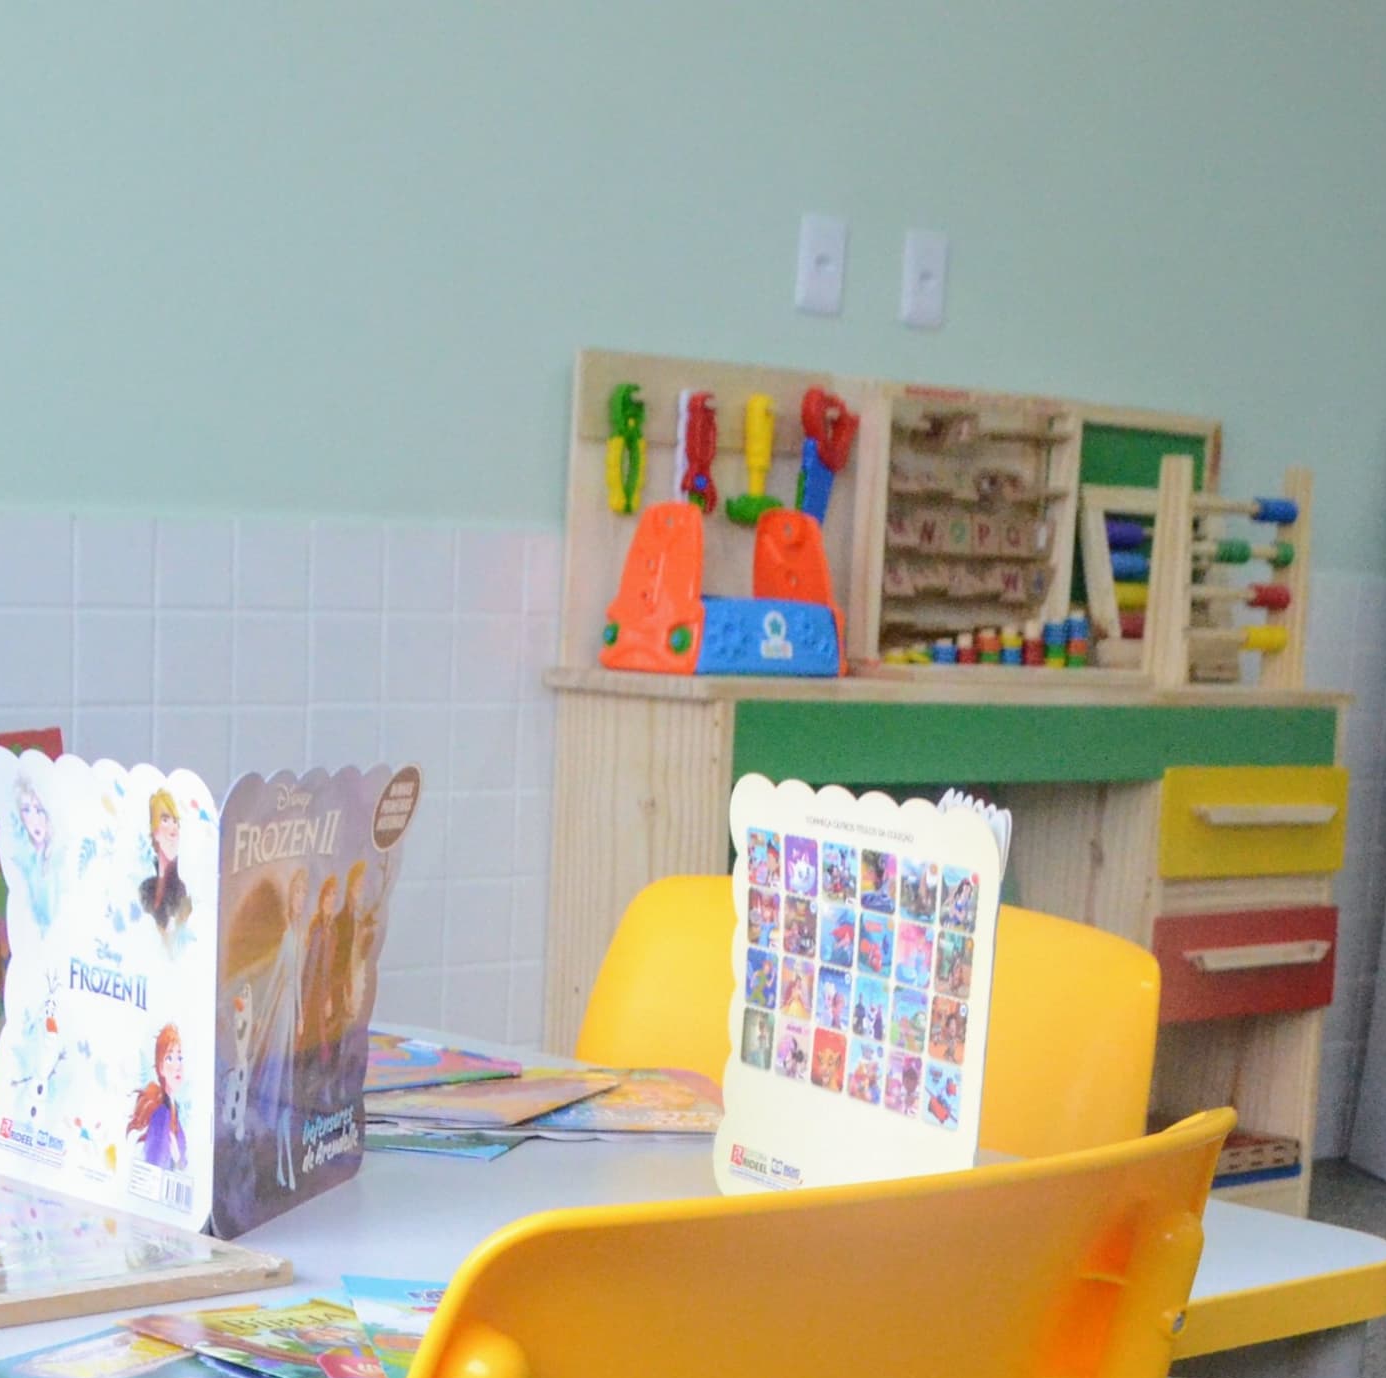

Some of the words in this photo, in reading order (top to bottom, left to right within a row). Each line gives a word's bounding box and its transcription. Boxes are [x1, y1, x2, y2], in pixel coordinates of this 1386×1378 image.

[233, 817, 320, 875] FROZEN
[317, 808, 341, 856] II
[69, 957, 132, 1003] FROZEN
[135, 975, 147, 1011] II
